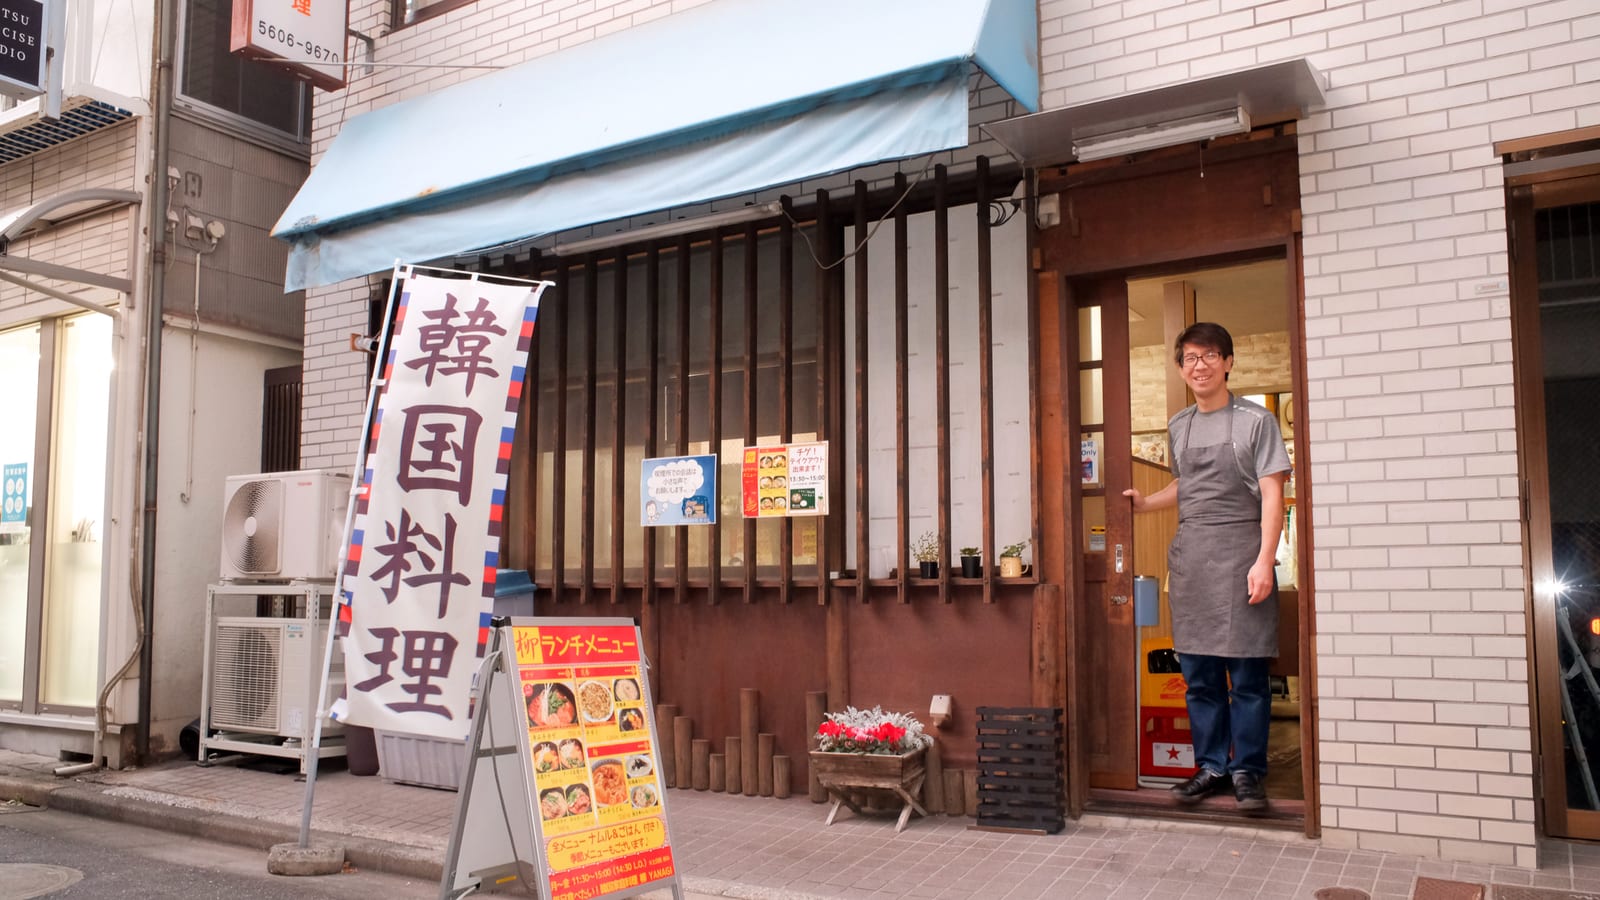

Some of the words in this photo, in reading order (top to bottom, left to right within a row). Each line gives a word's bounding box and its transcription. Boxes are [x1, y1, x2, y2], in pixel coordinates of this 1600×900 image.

[2, 27, 35, 46] CISE
[258, 20, 339, 63] 5606-9670
[353, 291, 507, 720] 韓国料理
[541, 633, 635, 656] ランチメニュー
